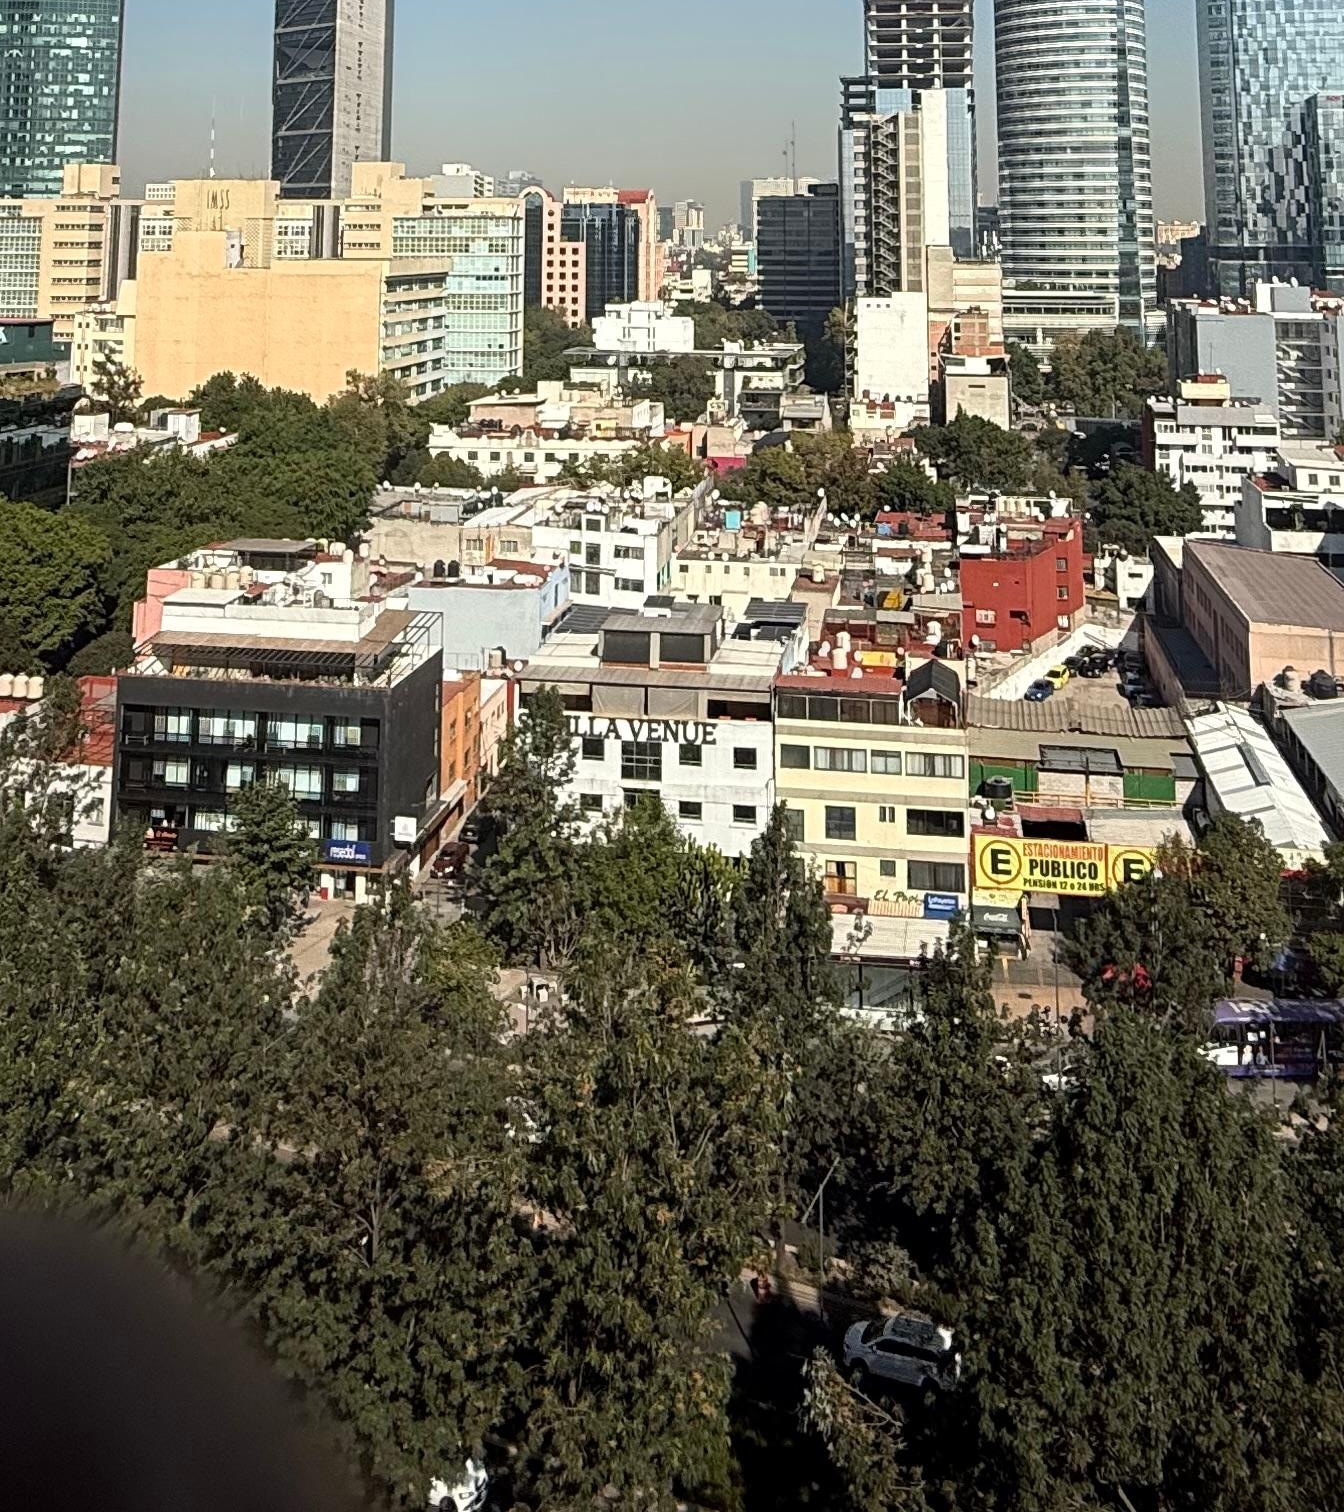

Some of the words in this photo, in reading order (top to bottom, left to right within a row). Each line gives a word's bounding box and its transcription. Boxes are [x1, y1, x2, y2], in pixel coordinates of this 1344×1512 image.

[206, 189, 230, 210] IMSS
[625, 718, 718, 745] VENUE
[990, 848, 1012, 876] E
[1022, 842, 1104, 862] ESTACIONAMIENTO
[1029, 858, 1099, 881] PUBLICO
